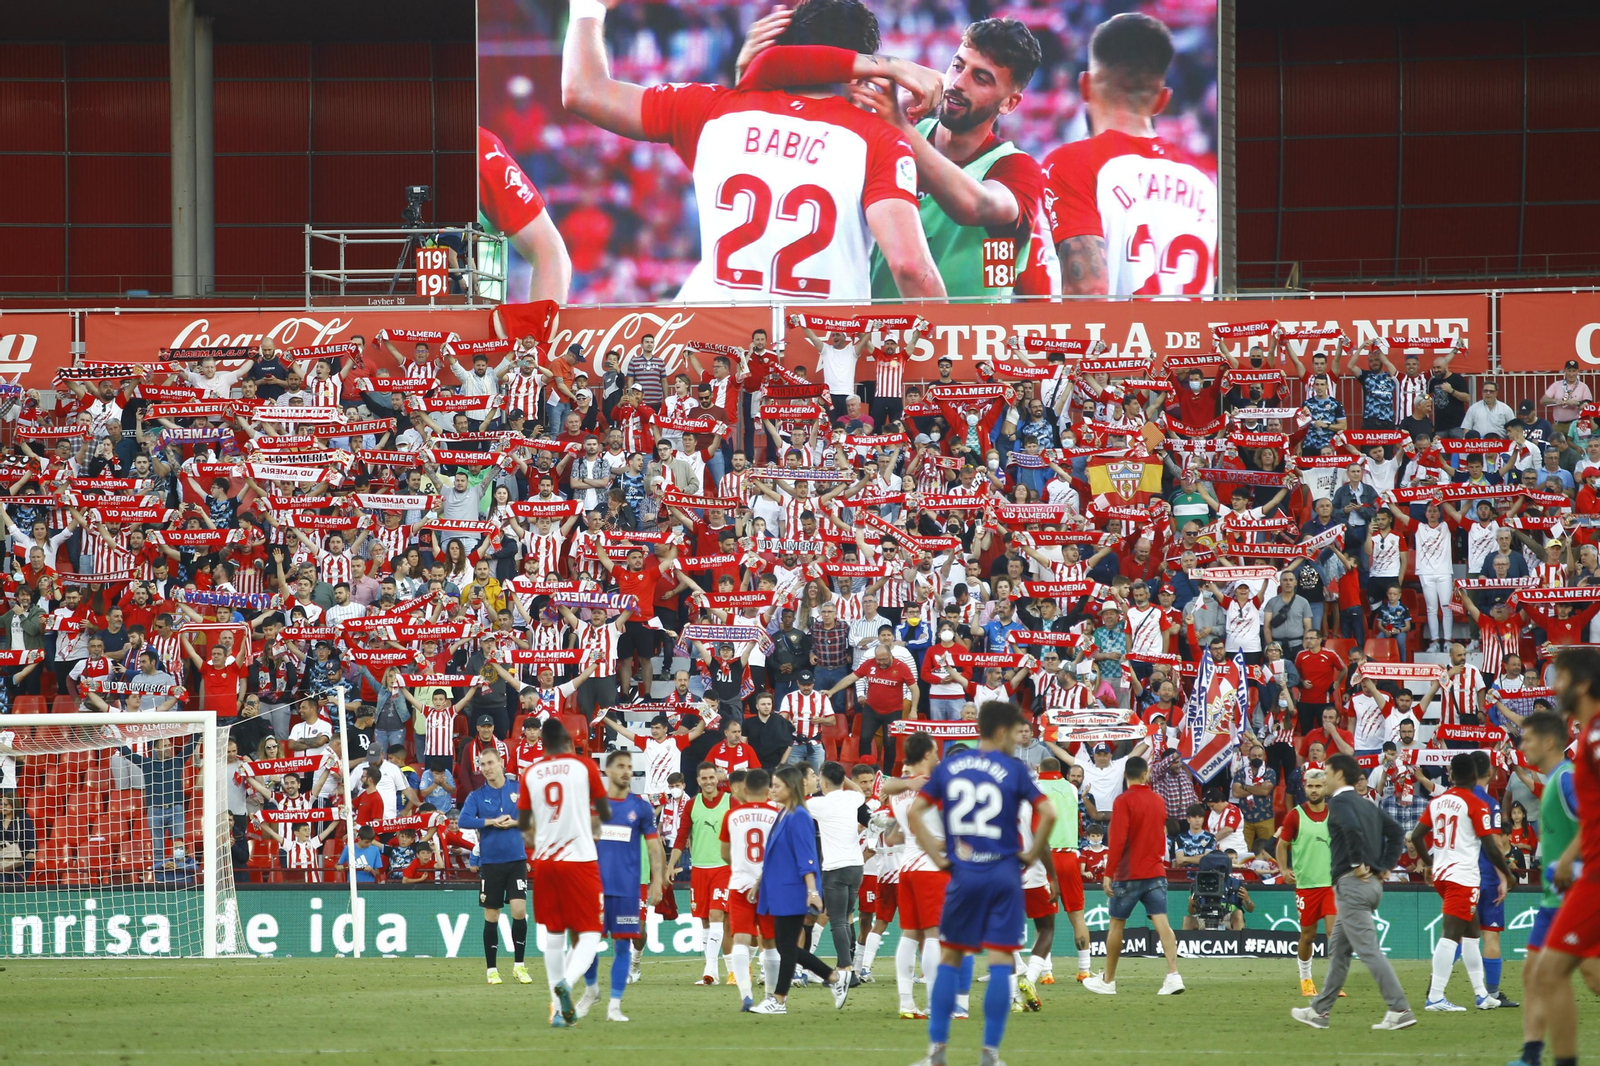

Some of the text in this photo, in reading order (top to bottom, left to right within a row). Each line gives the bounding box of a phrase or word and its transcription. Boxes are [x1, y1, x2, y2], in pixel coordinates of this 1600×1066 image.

[745, 127, 829, 165] BABIĆ
[714, 173, 837, 299] 22
[417, 251, 442, 269] 119
[983, 242, 1009, 260] 118
[985, 265, 1009, 286] 18
[418, 275, 441, 296] 19
[811, 317, 823, 325] UD
[1165, 331, 1200, 349] DE
[660, 416, 672, 424] UD
[1172, 421, 1184, 429] UD
[1018, 631, 1030, 639] UD
[870, 666, 876, 675] 2
[868, 676, 898, 686] HACKETT
[257, 762, 271, 770] UD
[537, 764, 570, 779] SADIQ
[544, 781, 564, 823] 9
[947, 778, 1003, 840] 22
[733, 813, 775, 826] PORTILLO
[1434, 813, 1458, 850] 31
[746, 828, 765, 864] 8
[310, 898, 407, 953] ida
[436, 913, 470, 957] y
